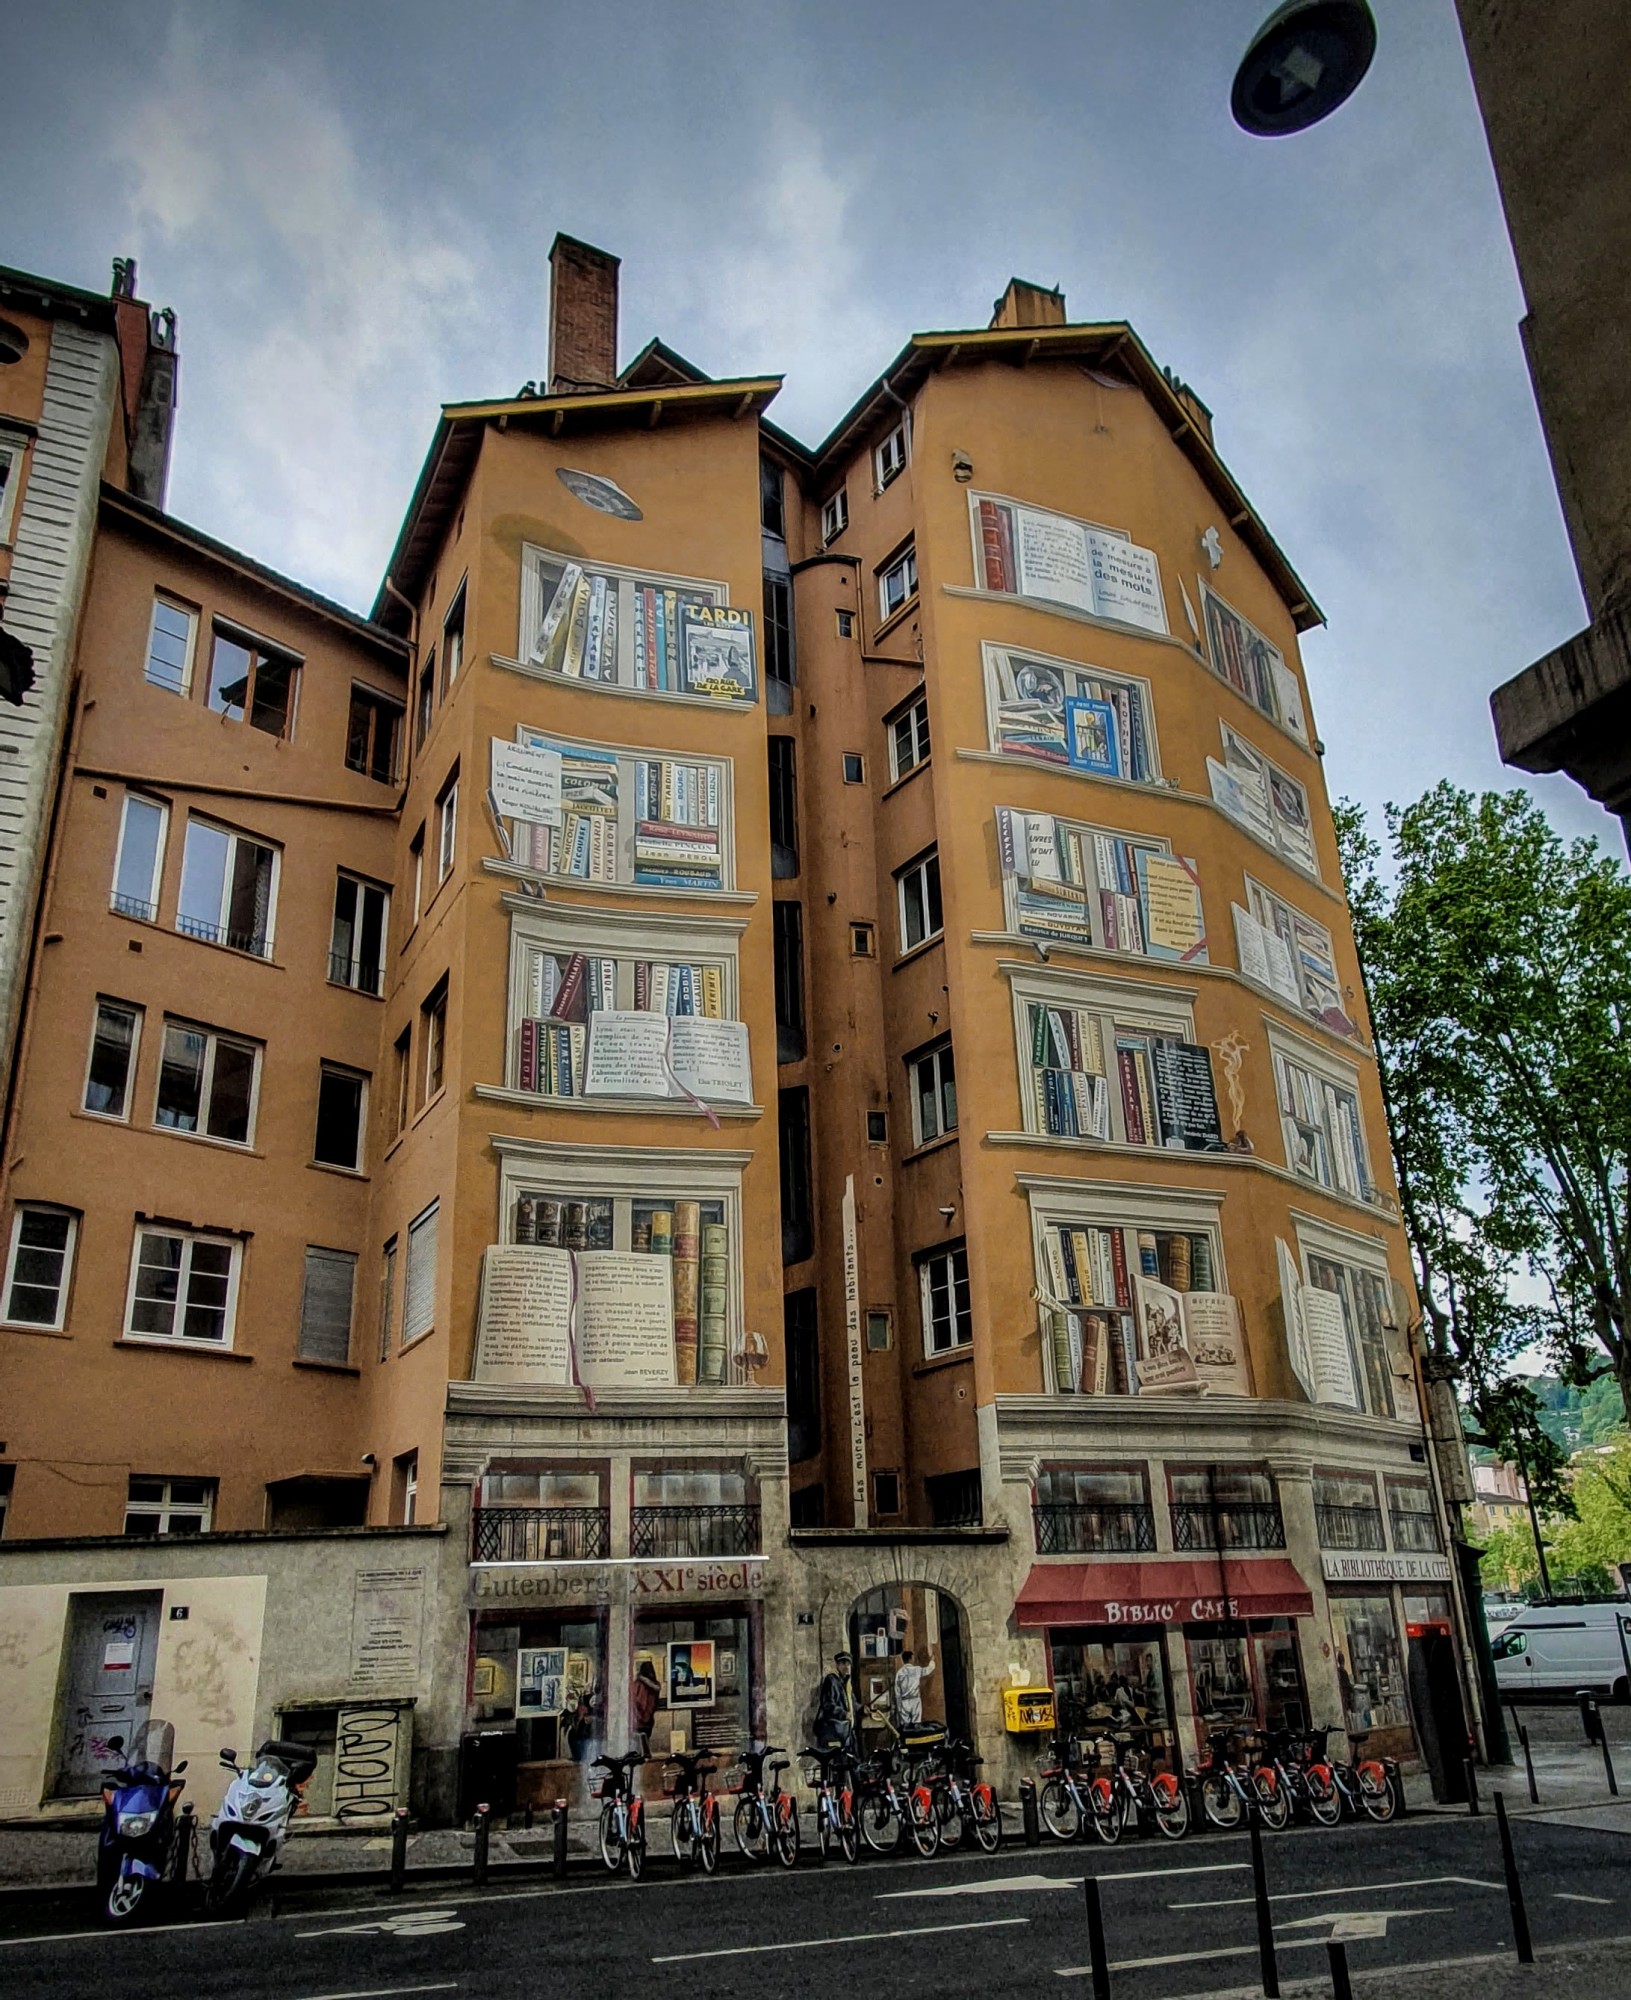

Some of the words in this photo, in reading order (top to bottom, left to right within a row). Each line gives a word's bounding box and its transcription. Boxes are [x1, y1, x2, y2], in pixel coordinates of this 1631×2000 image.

[1091, 548, 1103, 557] de
[1108, 553, 1142, 571] mesure
[1092, 558, 1102, 567] la
[1109, 563, 1152, 584] mesure
[1094, 569, 1117, 583] des
[686, 605, 748, 625] TARDI
[589, 615, 599, 671] FAYARD
[709, 683, 719, 691] LA
[564, 816, 576, 855] MICOLET
[1029, 823, 1040, 831] LES
[593, 820, 601, 874] BEURARD
[683, 878, 719, 887] MARTIN
[1047, 912, 1087, 921] NOVARINA
[566, 954, 584, 986] VIALATTE
[590, 959, 598, 996] EMMANUEL
[603, 963, 612, 991] PONGE
[561, 1029, 569, 1064] ZWEIG
[713, 1079, 743, 1088] TRIOLET
[1123, 1052, 1134, 1110] EXBRAYAT
[847, 1310, 857, 1329] des
[851, 1339, 863, 1367] peau
[849, 1374, 860, 1388] la
[851, 1397, 862, 1427] c'est
[854, 1480, 864, 1503] Les
[1325, 1558, 1340, 1578] LA
[1341, 1556, 1405, 1579] BIBLIOTHÈQUE
[1406, 1560, 1418, 1578] DE
[1420, 1560, 1432, 1578] LA
[471, 1567, 611, 1599] Gutenberg
[696, 1563, 763, 1591] siècle
[176, 1608, 183, 1618] 6
